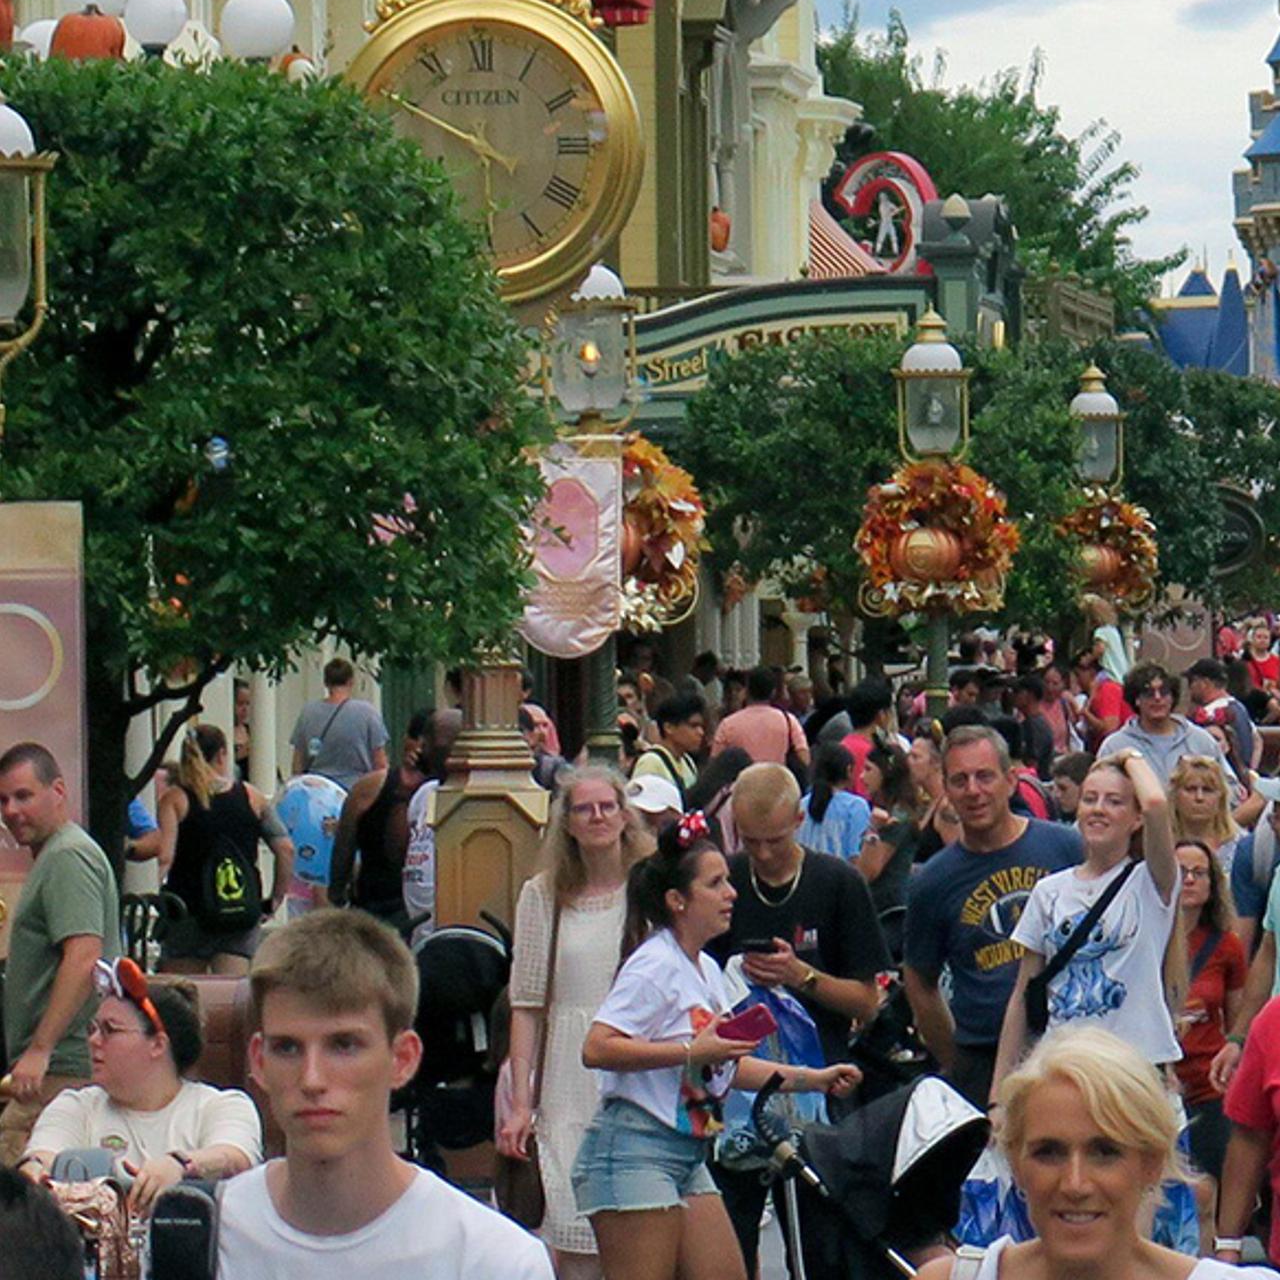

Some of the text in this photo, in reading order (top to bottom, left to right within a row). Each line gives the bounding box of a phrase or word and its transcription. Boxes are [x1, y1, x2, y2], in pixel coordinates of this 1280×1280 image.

[441, 89, 521, 104] CITIZEN
[647, 346, 708, 383] Street
[960, 880, 998, 926] WEST
